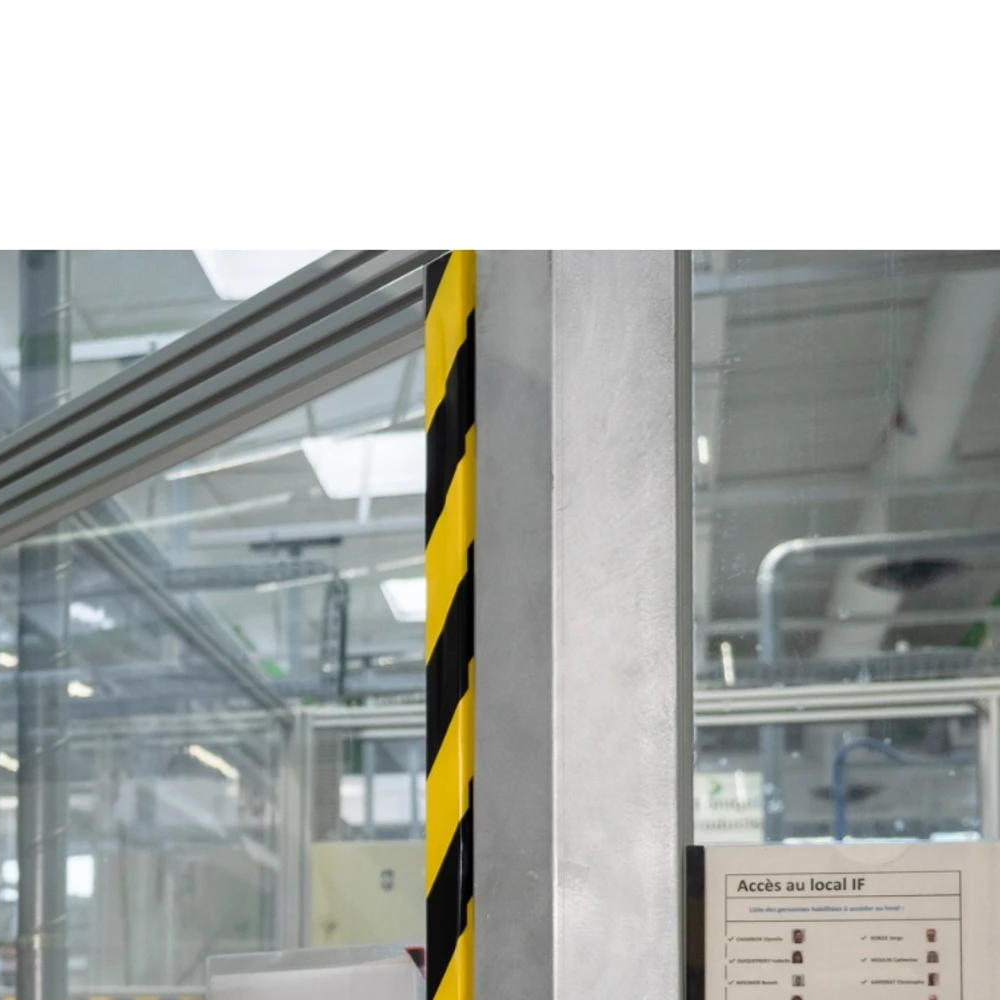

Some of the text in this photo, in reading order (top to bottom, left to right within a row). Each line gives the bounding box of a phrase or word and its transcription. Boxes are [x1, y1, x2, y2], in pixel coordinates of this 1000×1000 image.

[737, 878, 865, 892] Accès au local IF
